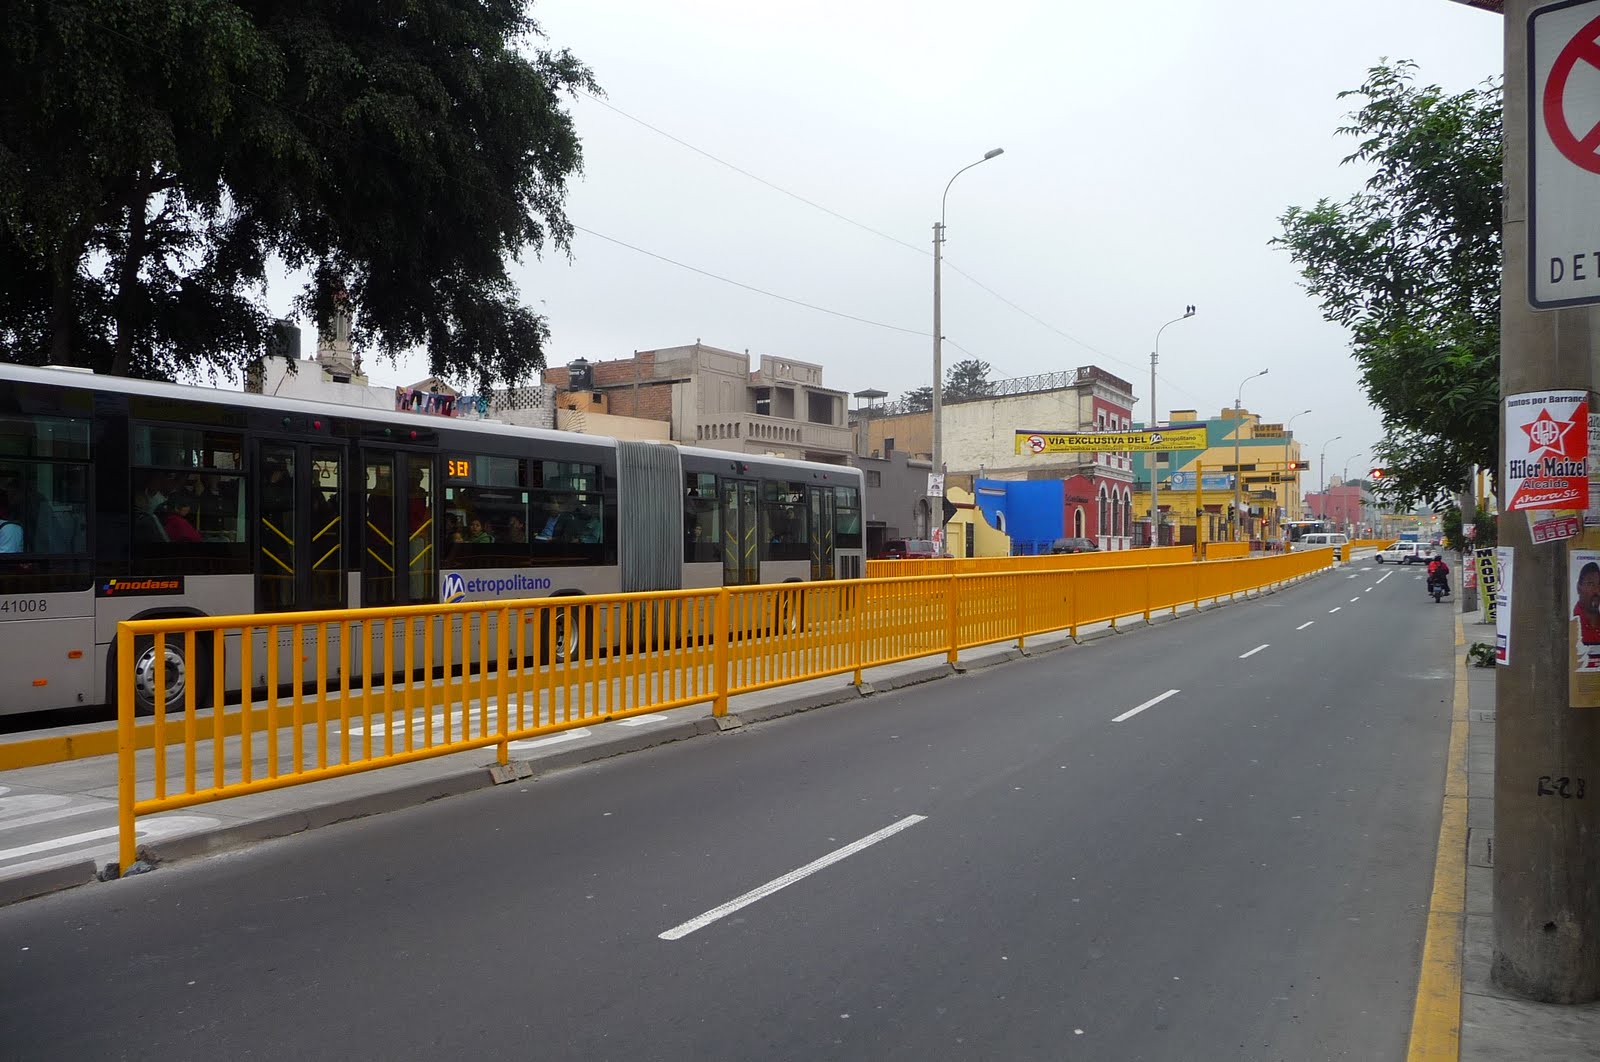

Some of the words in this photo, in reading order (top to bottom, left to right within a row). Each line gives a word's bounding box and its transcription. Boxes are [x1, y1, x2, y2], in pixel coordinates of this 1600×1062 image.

[1551, 252, 1600, 283] DET
[1532, 397, 1547, 405] por
[1149, 432, 1197, 446] Metropolitano
[1509, 459, 1541, 479] Hiler
[1543, 457, 1587, 477] Maizel
[1522, 479, 1568, 489] Alcalde
[1516, 491, 1562, 504] Ahora
[115, 579, 179, 590] modasa
[442, 573, 551, 603] Metropolitano
[1, 600, 47, 613] 41008
